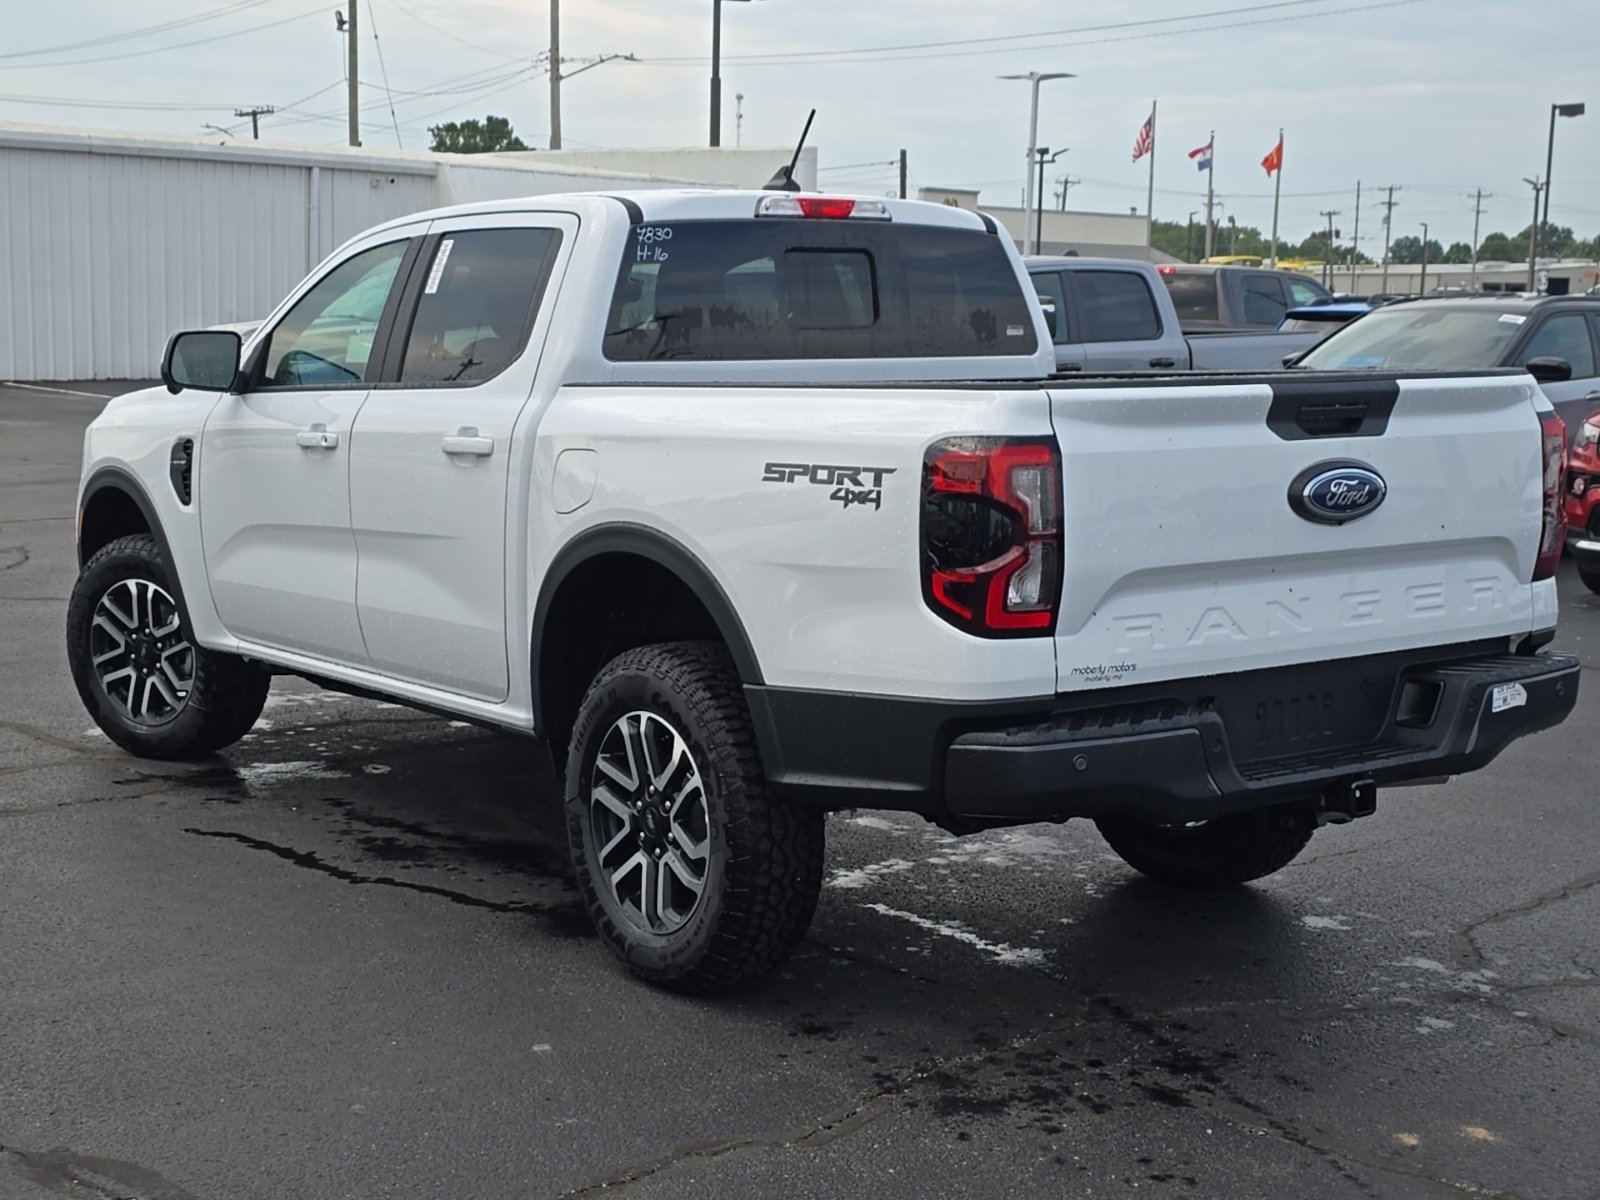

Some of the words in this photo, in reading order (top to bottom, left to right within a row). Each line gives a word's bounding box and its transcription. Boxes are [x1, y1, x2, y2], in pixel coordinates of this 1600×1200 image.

[637, 227, 673, 243] 7830
[761, 462, 898, 488] SPORT
[1326, 479, 1370, 506] Ford
[1112, 575, 1503, 653] RANGER
[1071, 664, 1107, 675] moberly
[1107, 660, 1138, 673] motors
